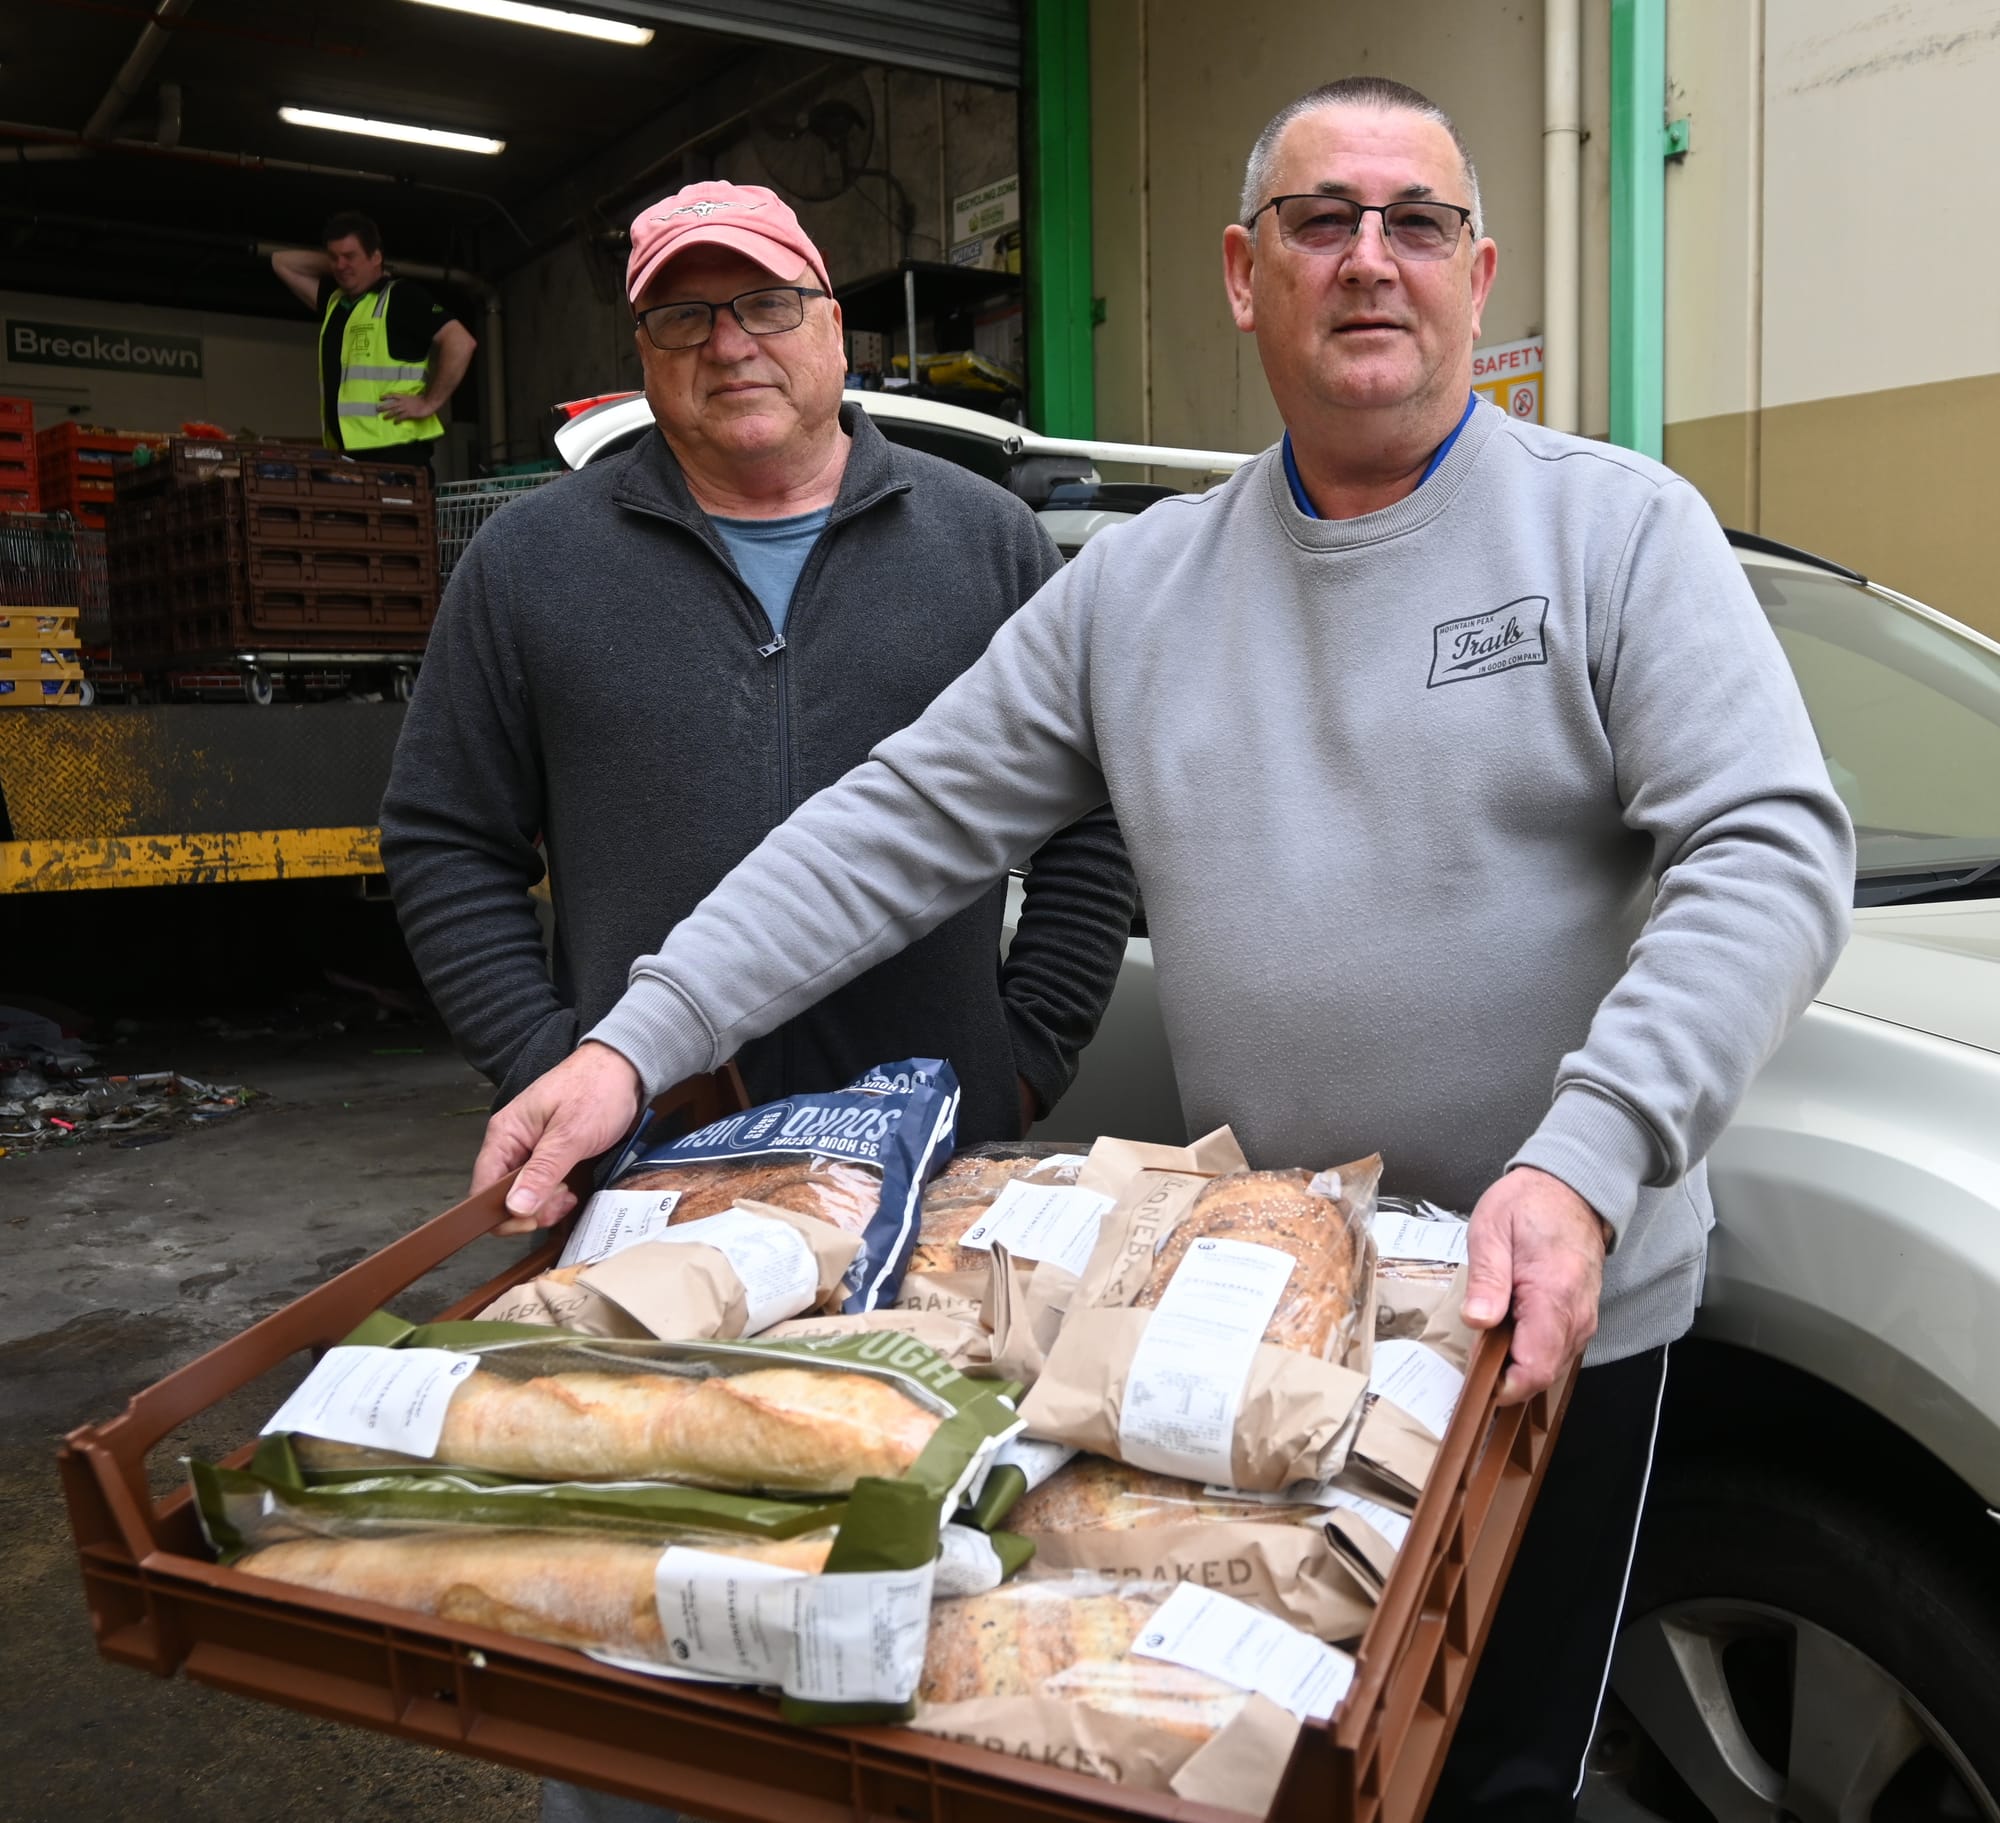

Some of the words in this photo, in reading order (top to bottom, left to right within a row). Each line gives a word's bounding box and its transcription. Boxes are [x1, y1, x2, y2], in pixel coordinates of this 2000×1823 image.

[956, 188, 996, 213] RECYCLING
[997, 180, 1017, 197] ZONE
[952, 243, 981, 264] NOTICE
[14, 327, 200, 369] Breakdown
[1473, 346, 1544, 376] SAFETY
[1440, 620, 1475, 634] MOUNTAIN
[1476, 616, 1494, 626] PEAK
[1452, 616, 1524, 660] Trails
[1487, 660, 1507, 672] GOOD
[1508, 653, 1541, 665] COMPANY
[768, 1136, 815, 1146] RECIPE
[818, 1136, 858, 1154] HOUR
[860, 1143, 880, 1157] 35
